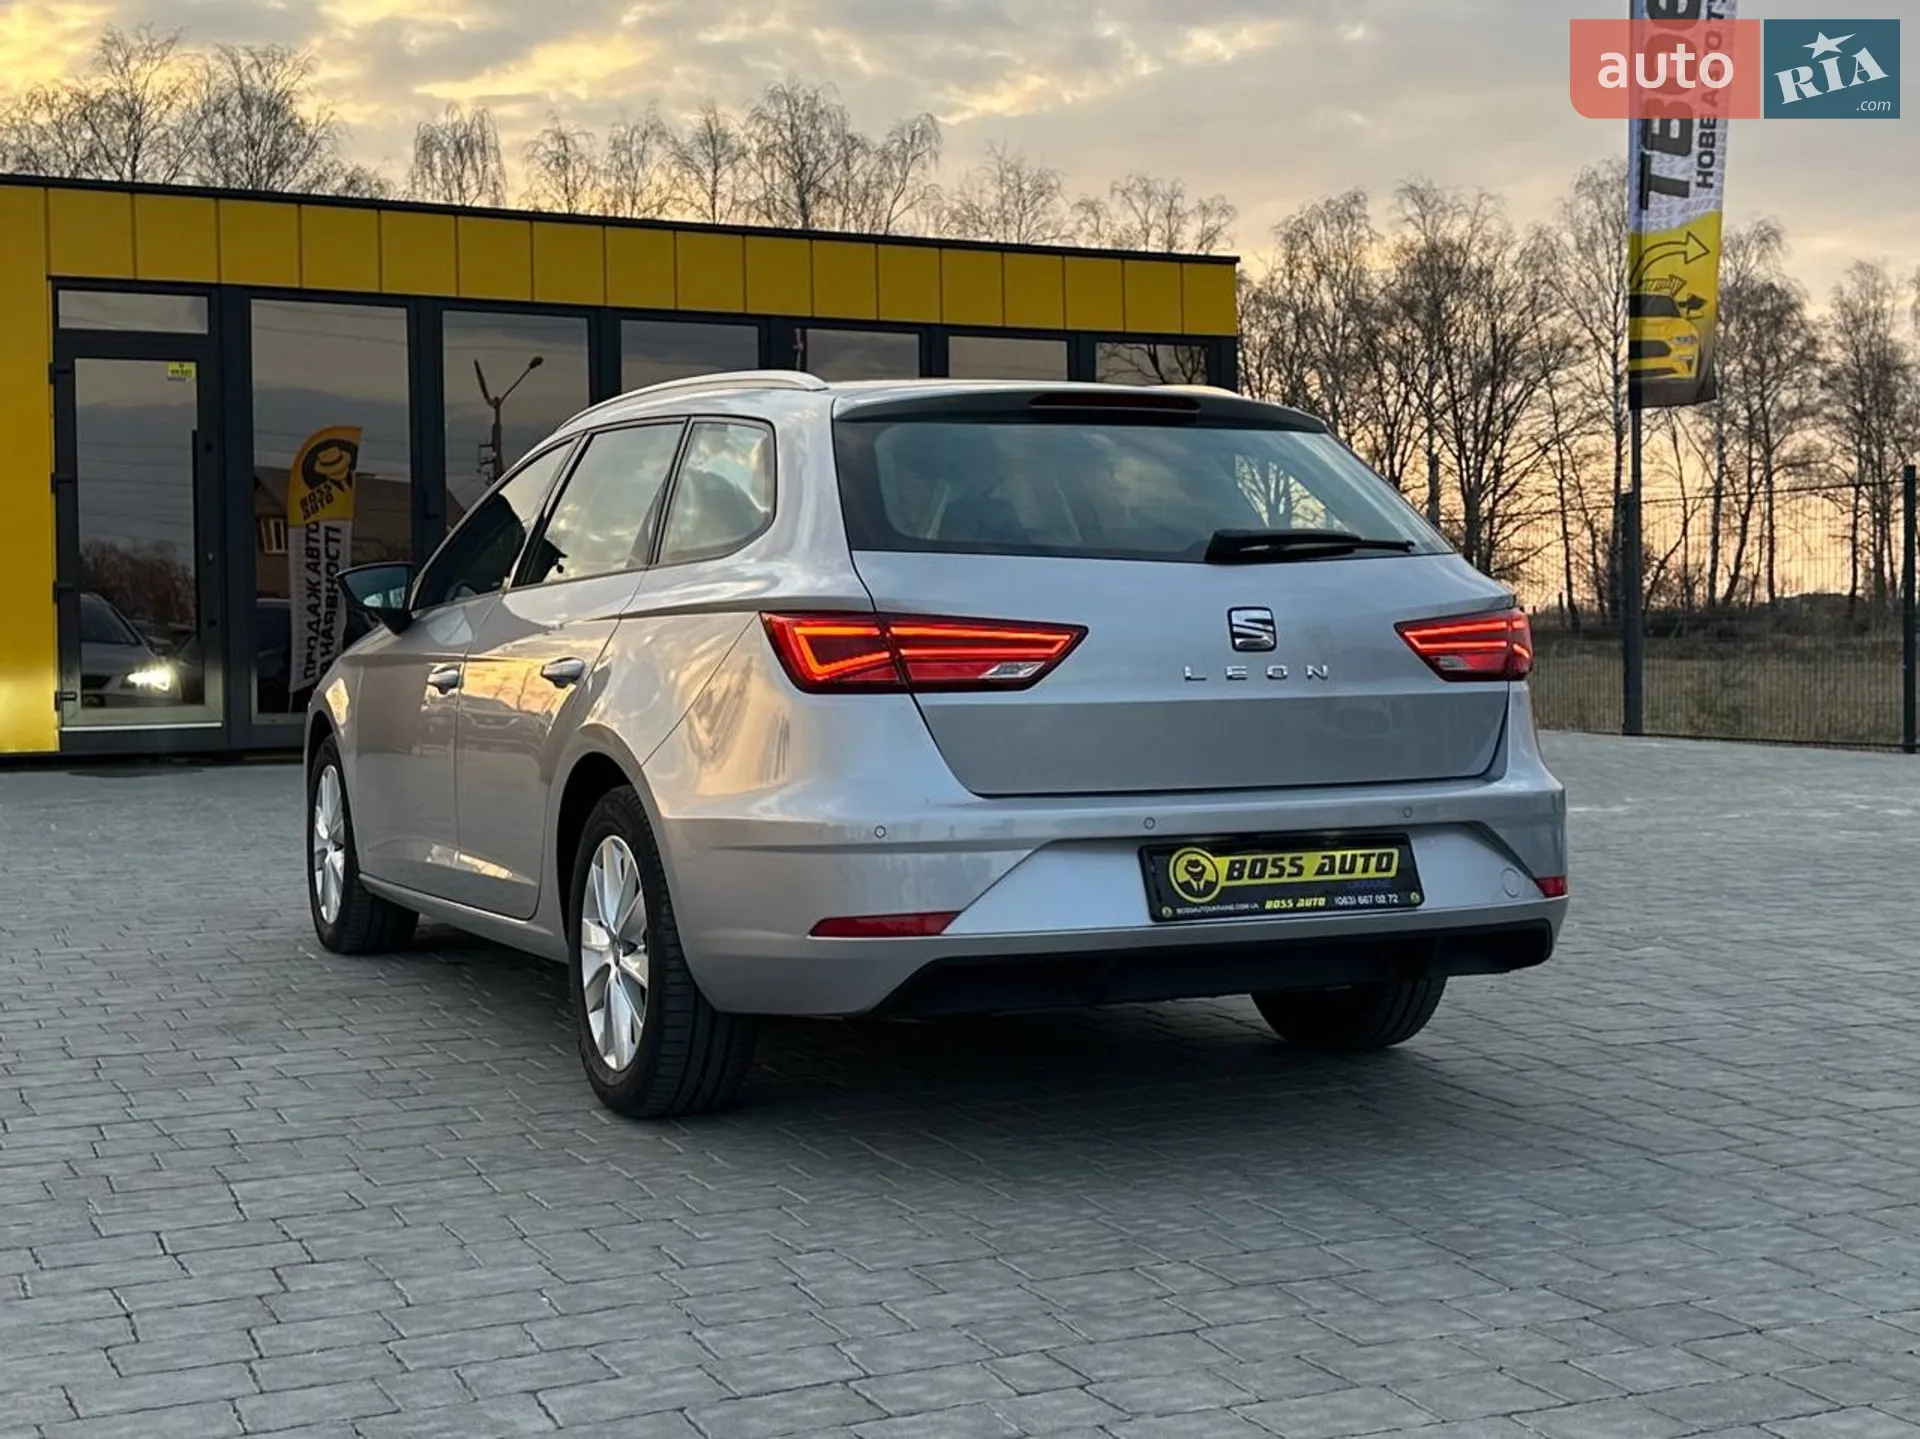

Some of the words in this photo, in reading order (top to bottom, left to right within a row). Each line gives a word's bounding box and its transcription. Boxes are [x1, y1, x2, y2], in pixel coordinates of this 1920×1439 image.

[1696, 112, 1718, 189] НОВЕ
[300, 484, 333, 510] BOSS
[303, 491, 335, 520] AUTO
[305, 521, 321, 576] АВТО
[322, 525, 342, 656] НАЯВНОСТІ
[304, 581, 322, 680] ПРОДАЖ
[1183, 665, 1330, 682] LEON
[1225, 857, 1306, 881] BOSS
[1314, 852, 1396, 877] AUTO
[1265, 899, 1293, 910] BOSS
[1296, 897, 1326, 907] AUTO
[1387, 893, 1399, 904] 72
